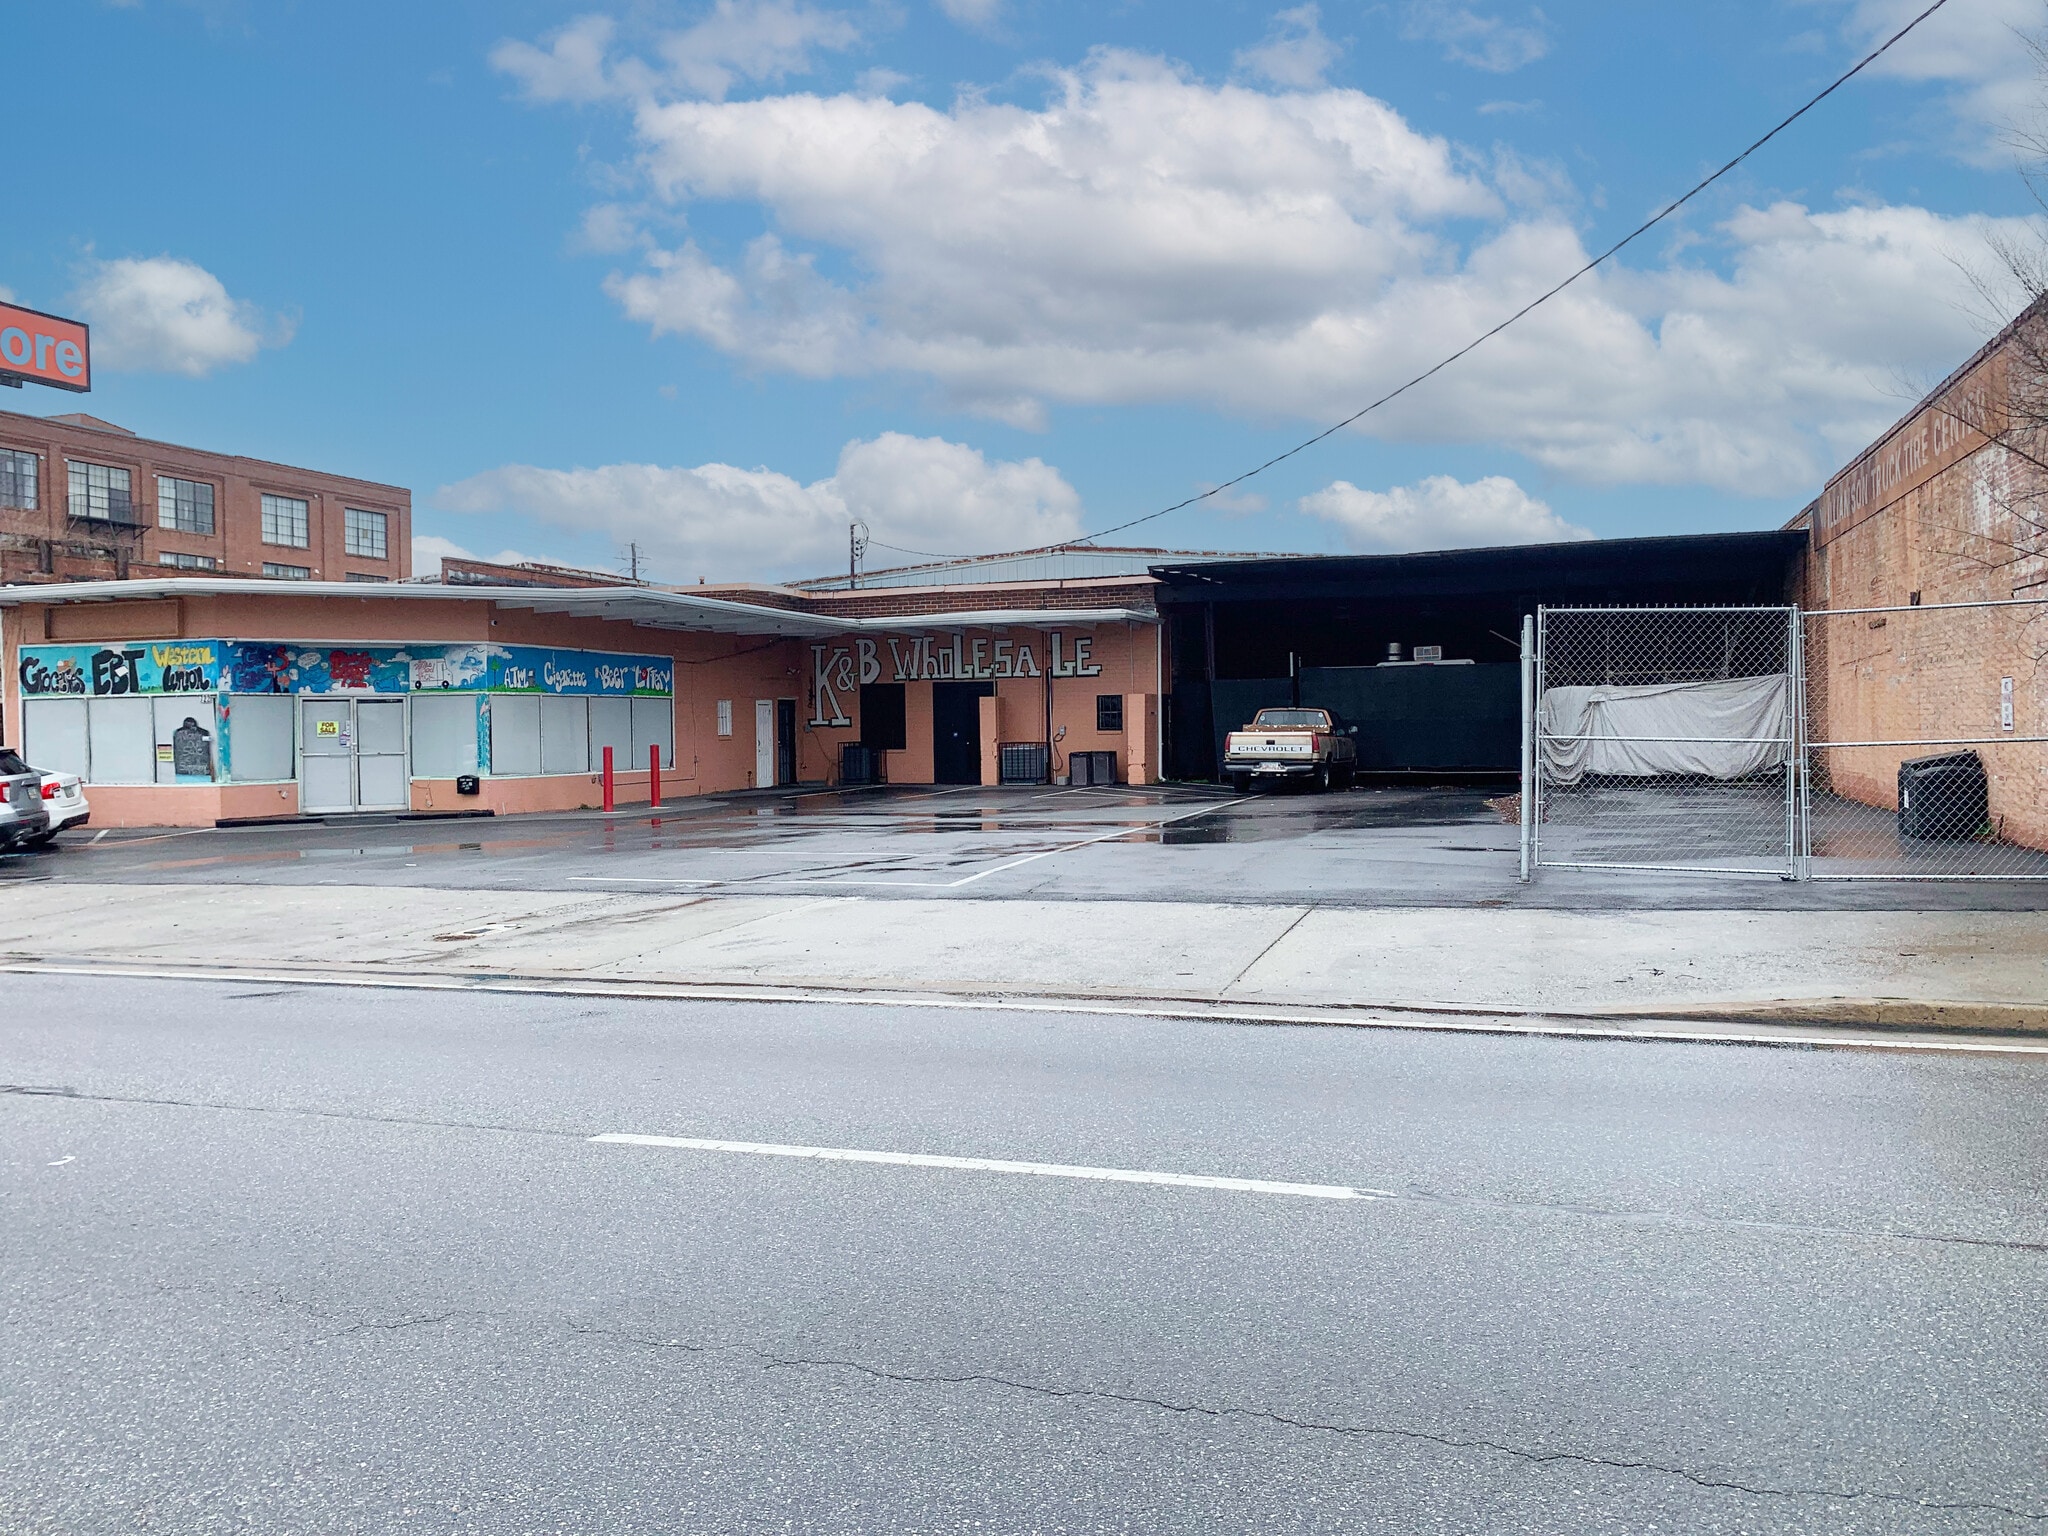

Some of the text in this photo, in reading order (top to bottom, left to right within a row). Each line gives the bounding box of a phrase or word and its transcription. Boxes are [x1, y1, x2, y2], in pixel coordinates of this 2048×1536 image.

[0, 326, 83, 377] ore
[1870, 447, 1902, 500] TRUCK
[1903, 428, 1929, 476] TIRE
[1933, 387, 1986, 457] CENTER
[91, 649, 146, 695] EBT
